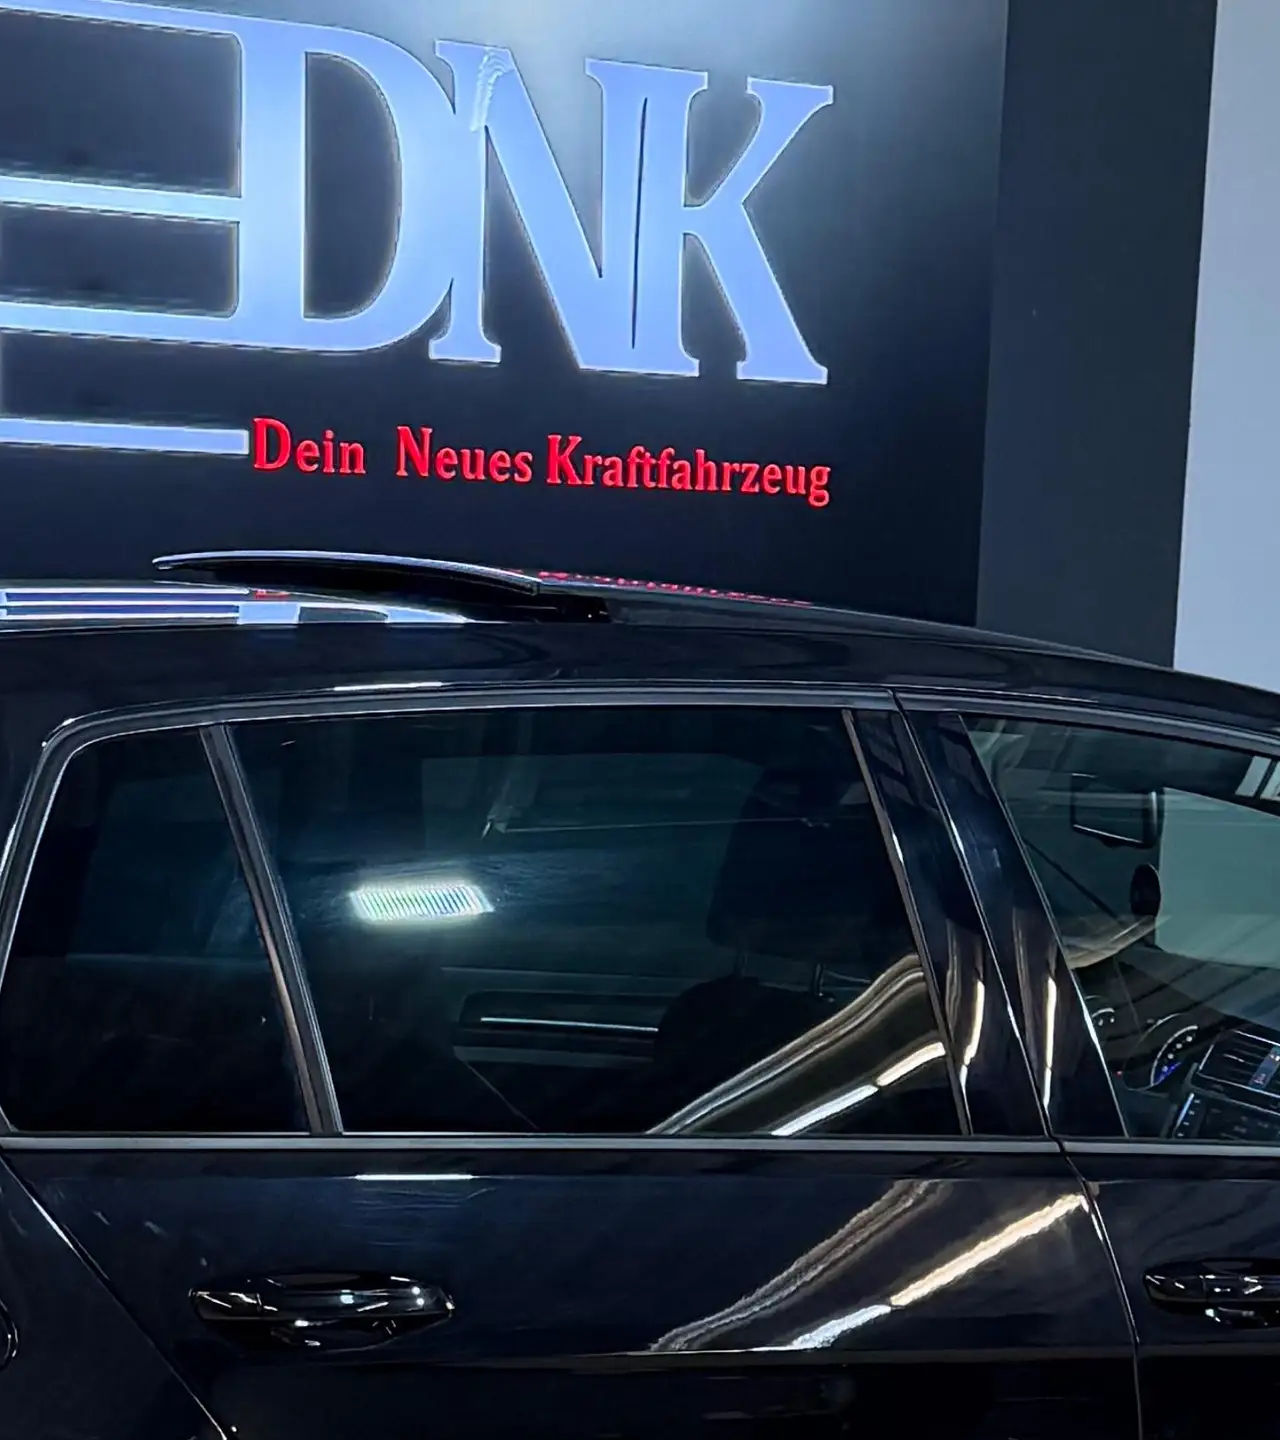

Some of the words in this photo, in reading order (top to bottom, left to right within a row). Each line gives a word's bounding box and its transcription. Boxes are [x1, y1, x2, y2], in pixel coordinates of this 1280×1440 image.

[239, 17, 834, 386] DNK
[251, 417, 366, 475] Dein
[396, 425, 534, 484] Neues
[546, 434, 831, 507] Kraftfahrzeug
